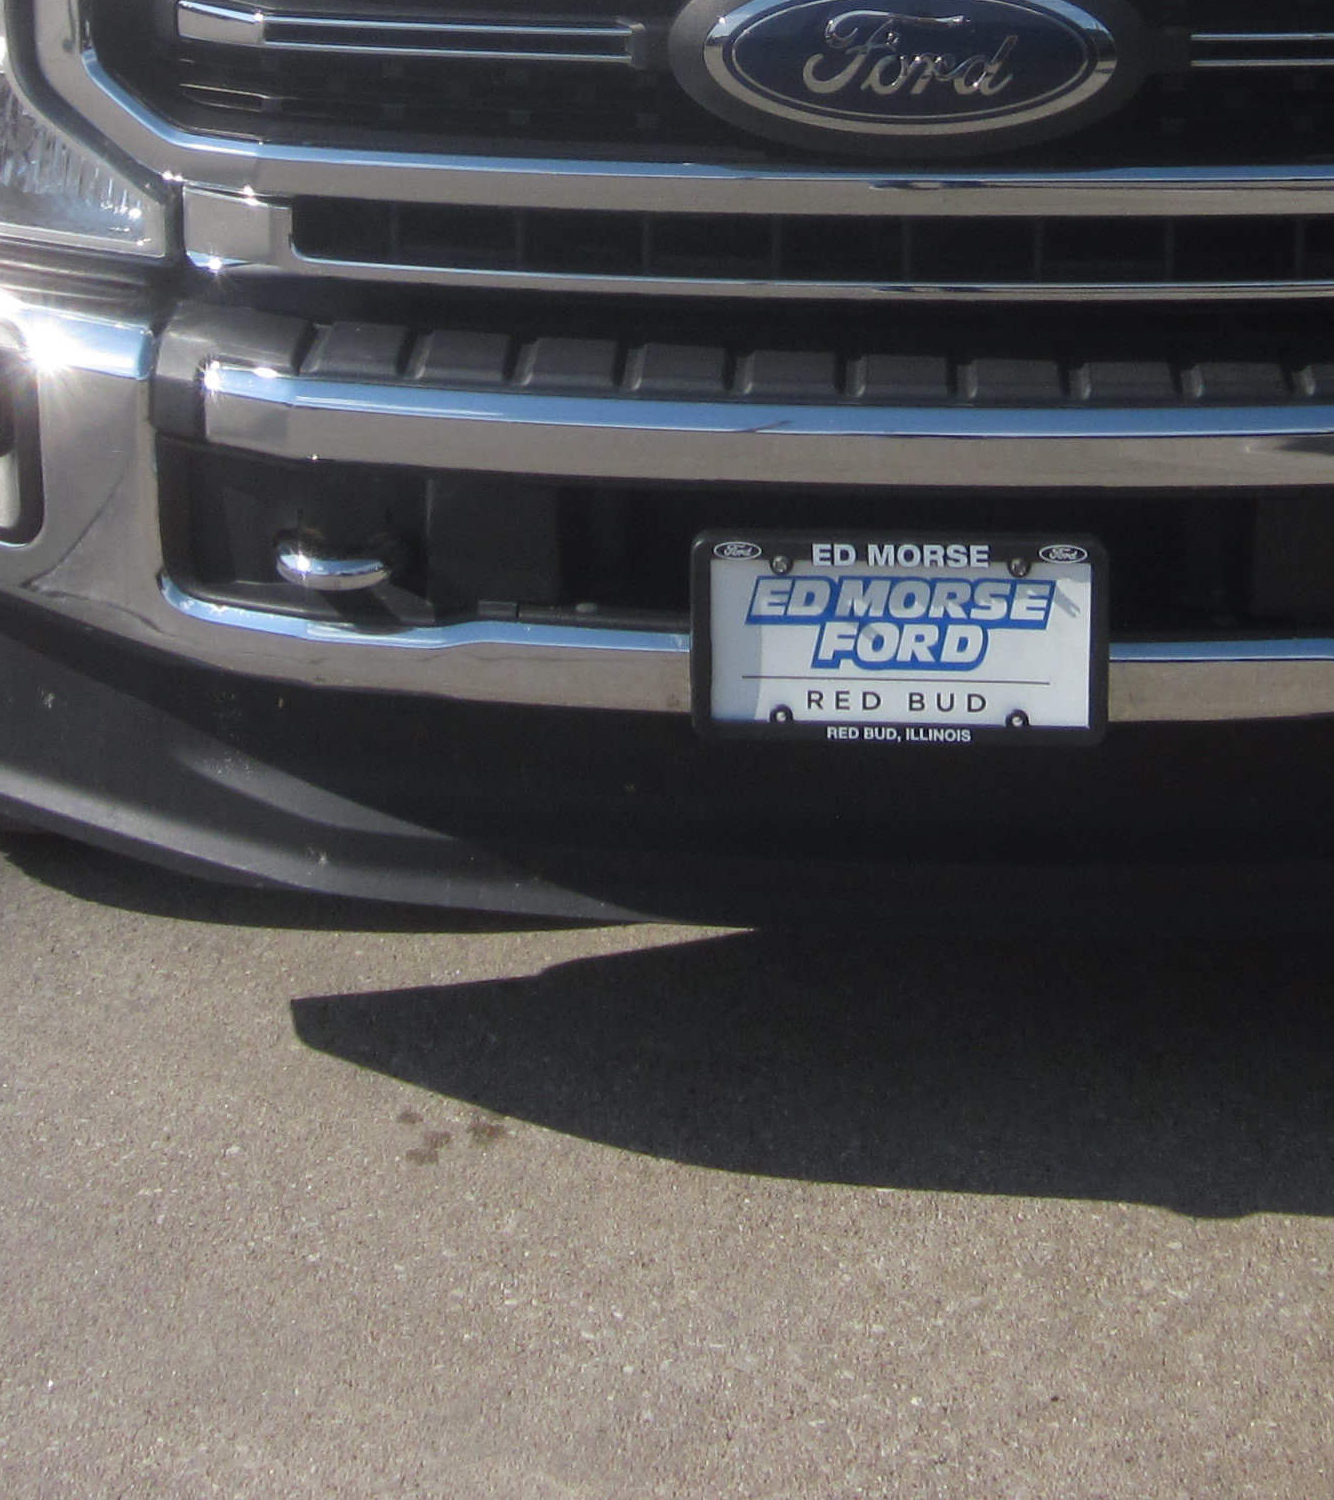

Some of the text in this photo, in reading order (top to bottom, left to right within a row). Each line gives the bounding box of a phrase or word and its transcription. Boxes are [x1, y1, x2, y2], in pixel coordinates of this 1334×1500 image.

[803, 10, 1018, 96] Ford
[723, 543, 753, 557] Ford
[812, 543, 990, 569] ED MORSE
[1048, 547, 1079, 560] Ford
[816, 620, 985, 665] FORD
[807, 690, 987, 713] RED BUD
[826, 726, 972, 743] RED BUD, ILLINOIS
